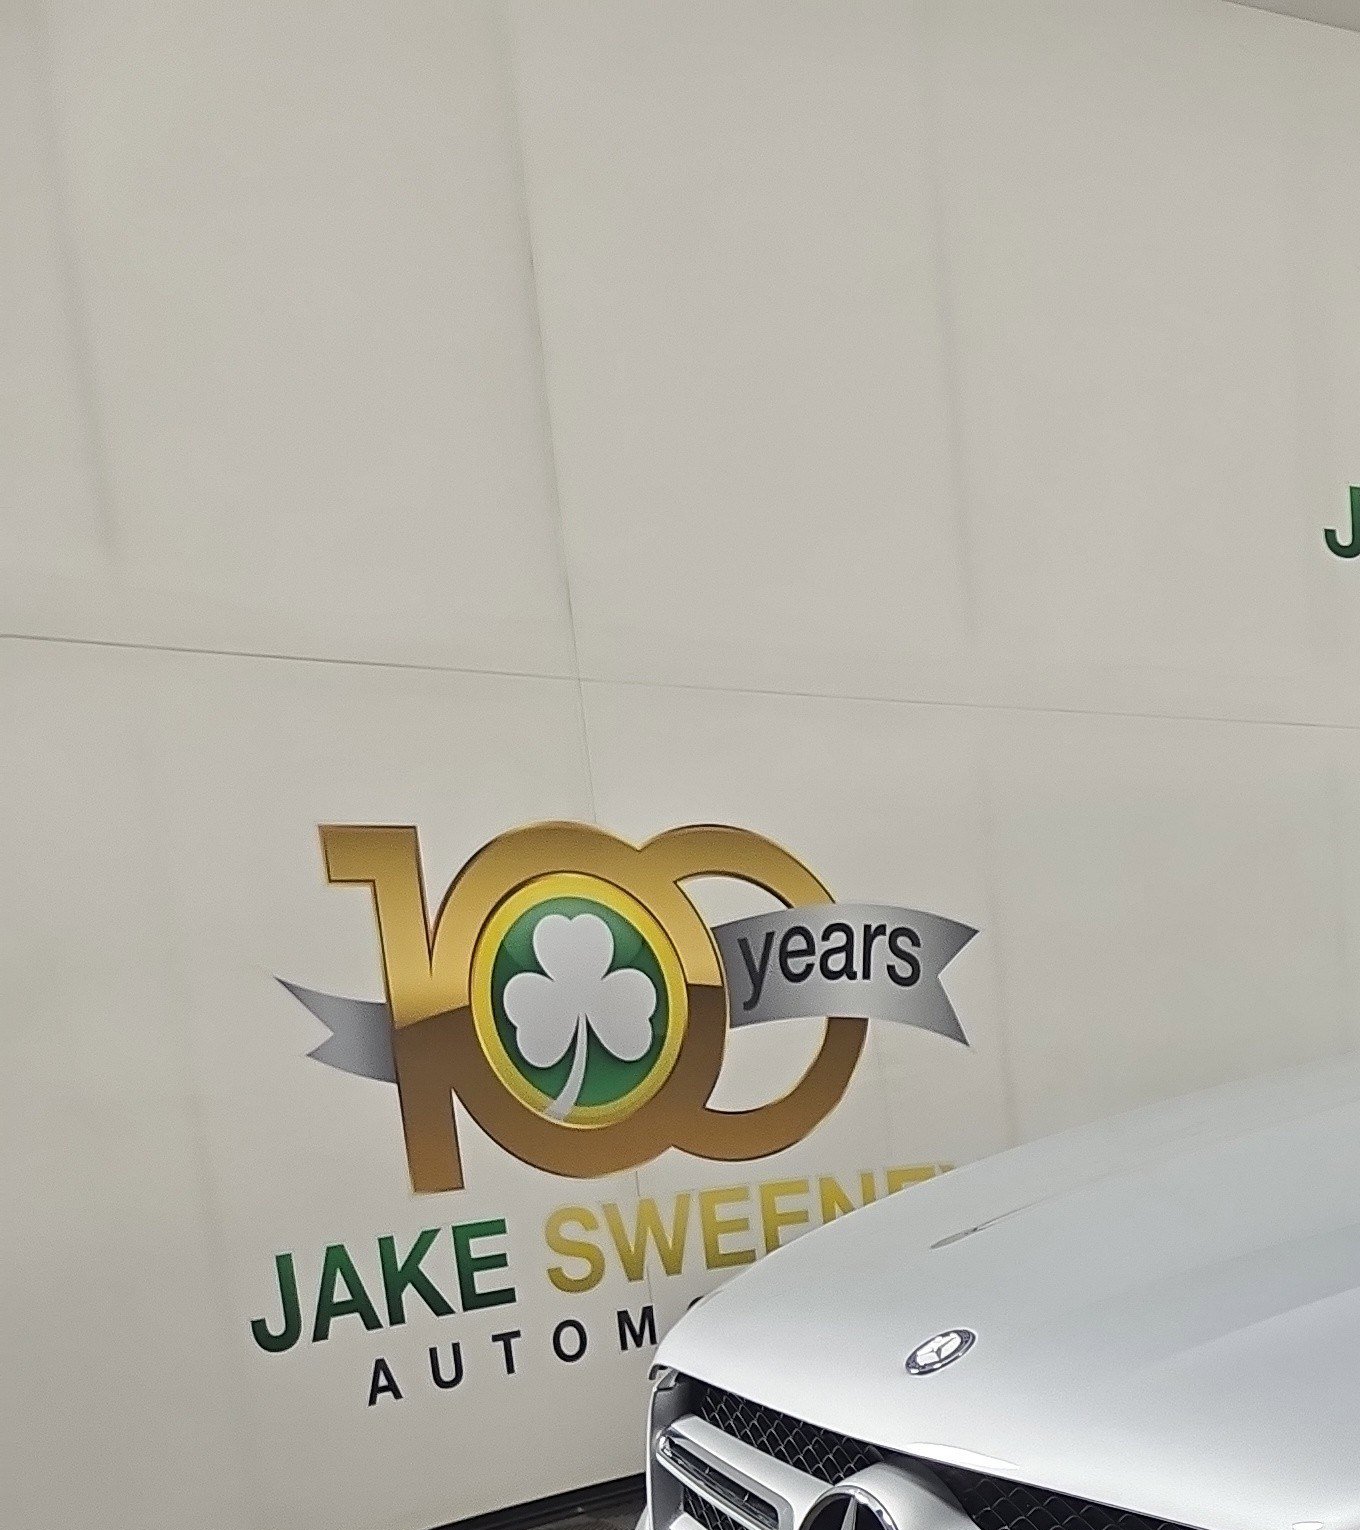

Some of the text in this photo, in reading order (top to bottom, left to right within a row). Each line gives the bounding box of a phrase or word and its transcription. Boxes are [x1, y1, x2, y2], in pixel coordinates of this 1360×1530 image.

[317, 820, 869, 1194] 100
[737, 921, 922, 1011] years
[250, 1162, 955, 1354] JAKE SWEEN
[366, 1297, 704, 1407] AUTOM
